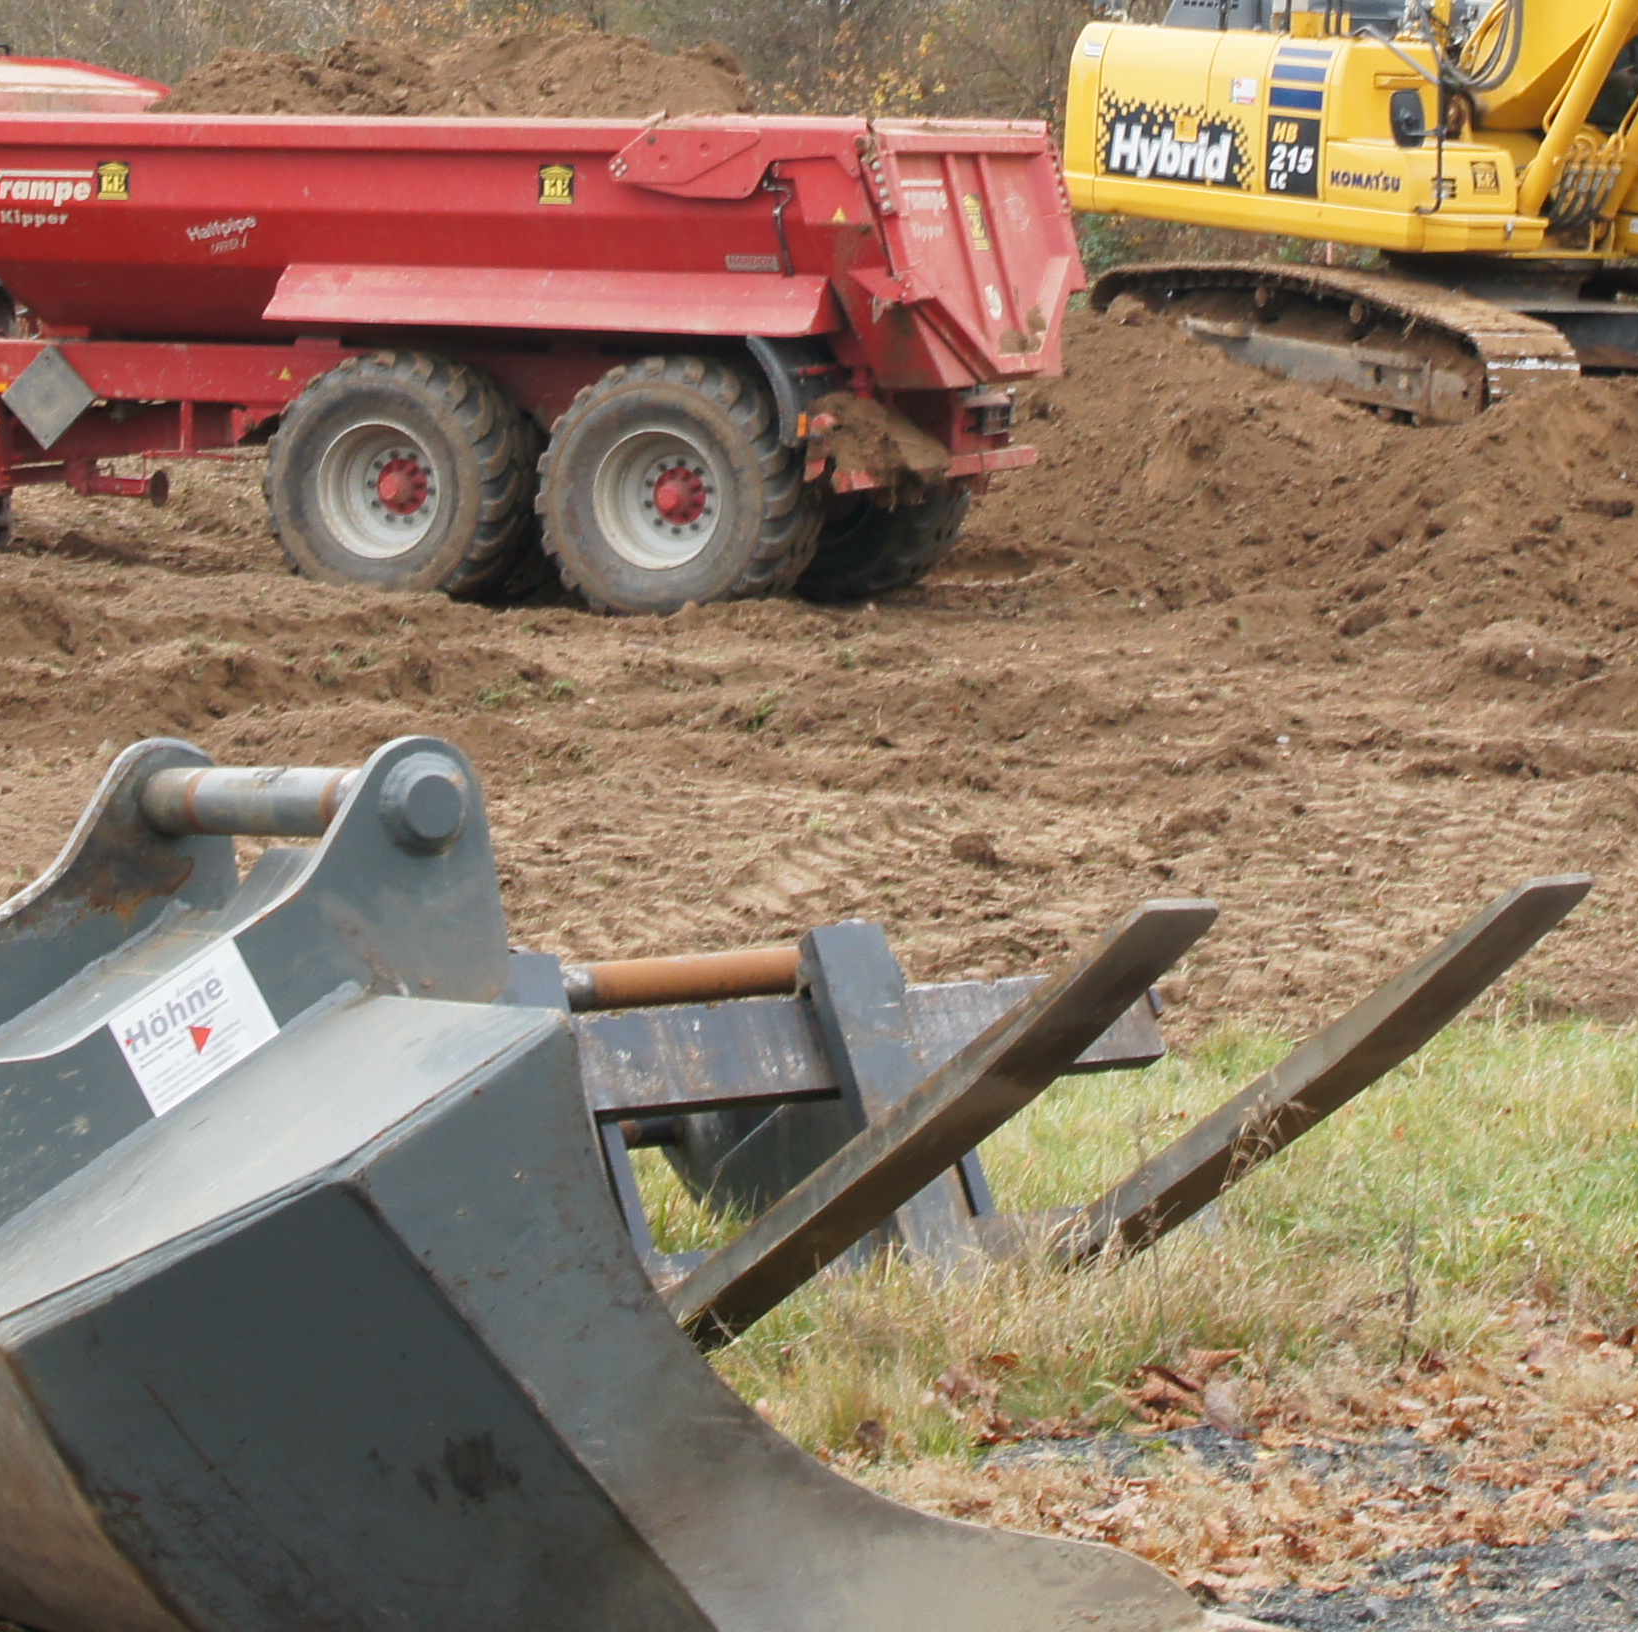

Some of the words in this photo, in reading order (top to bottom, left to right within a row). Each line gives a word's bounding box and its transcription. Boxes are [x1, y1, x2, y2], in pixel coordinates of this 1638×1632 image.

[1271, 121, 1300, 143] HB
[1109, 121, 1233, 183] Hybrid
[1269, 144, 1315, 175] 215
[1269, 171, 1288, 191] LC
[1330, 170, 1401, 192] KOMATSU
[0, 209, 69, 228] Kipper
[124, 976, 225, 1055] Höhne
